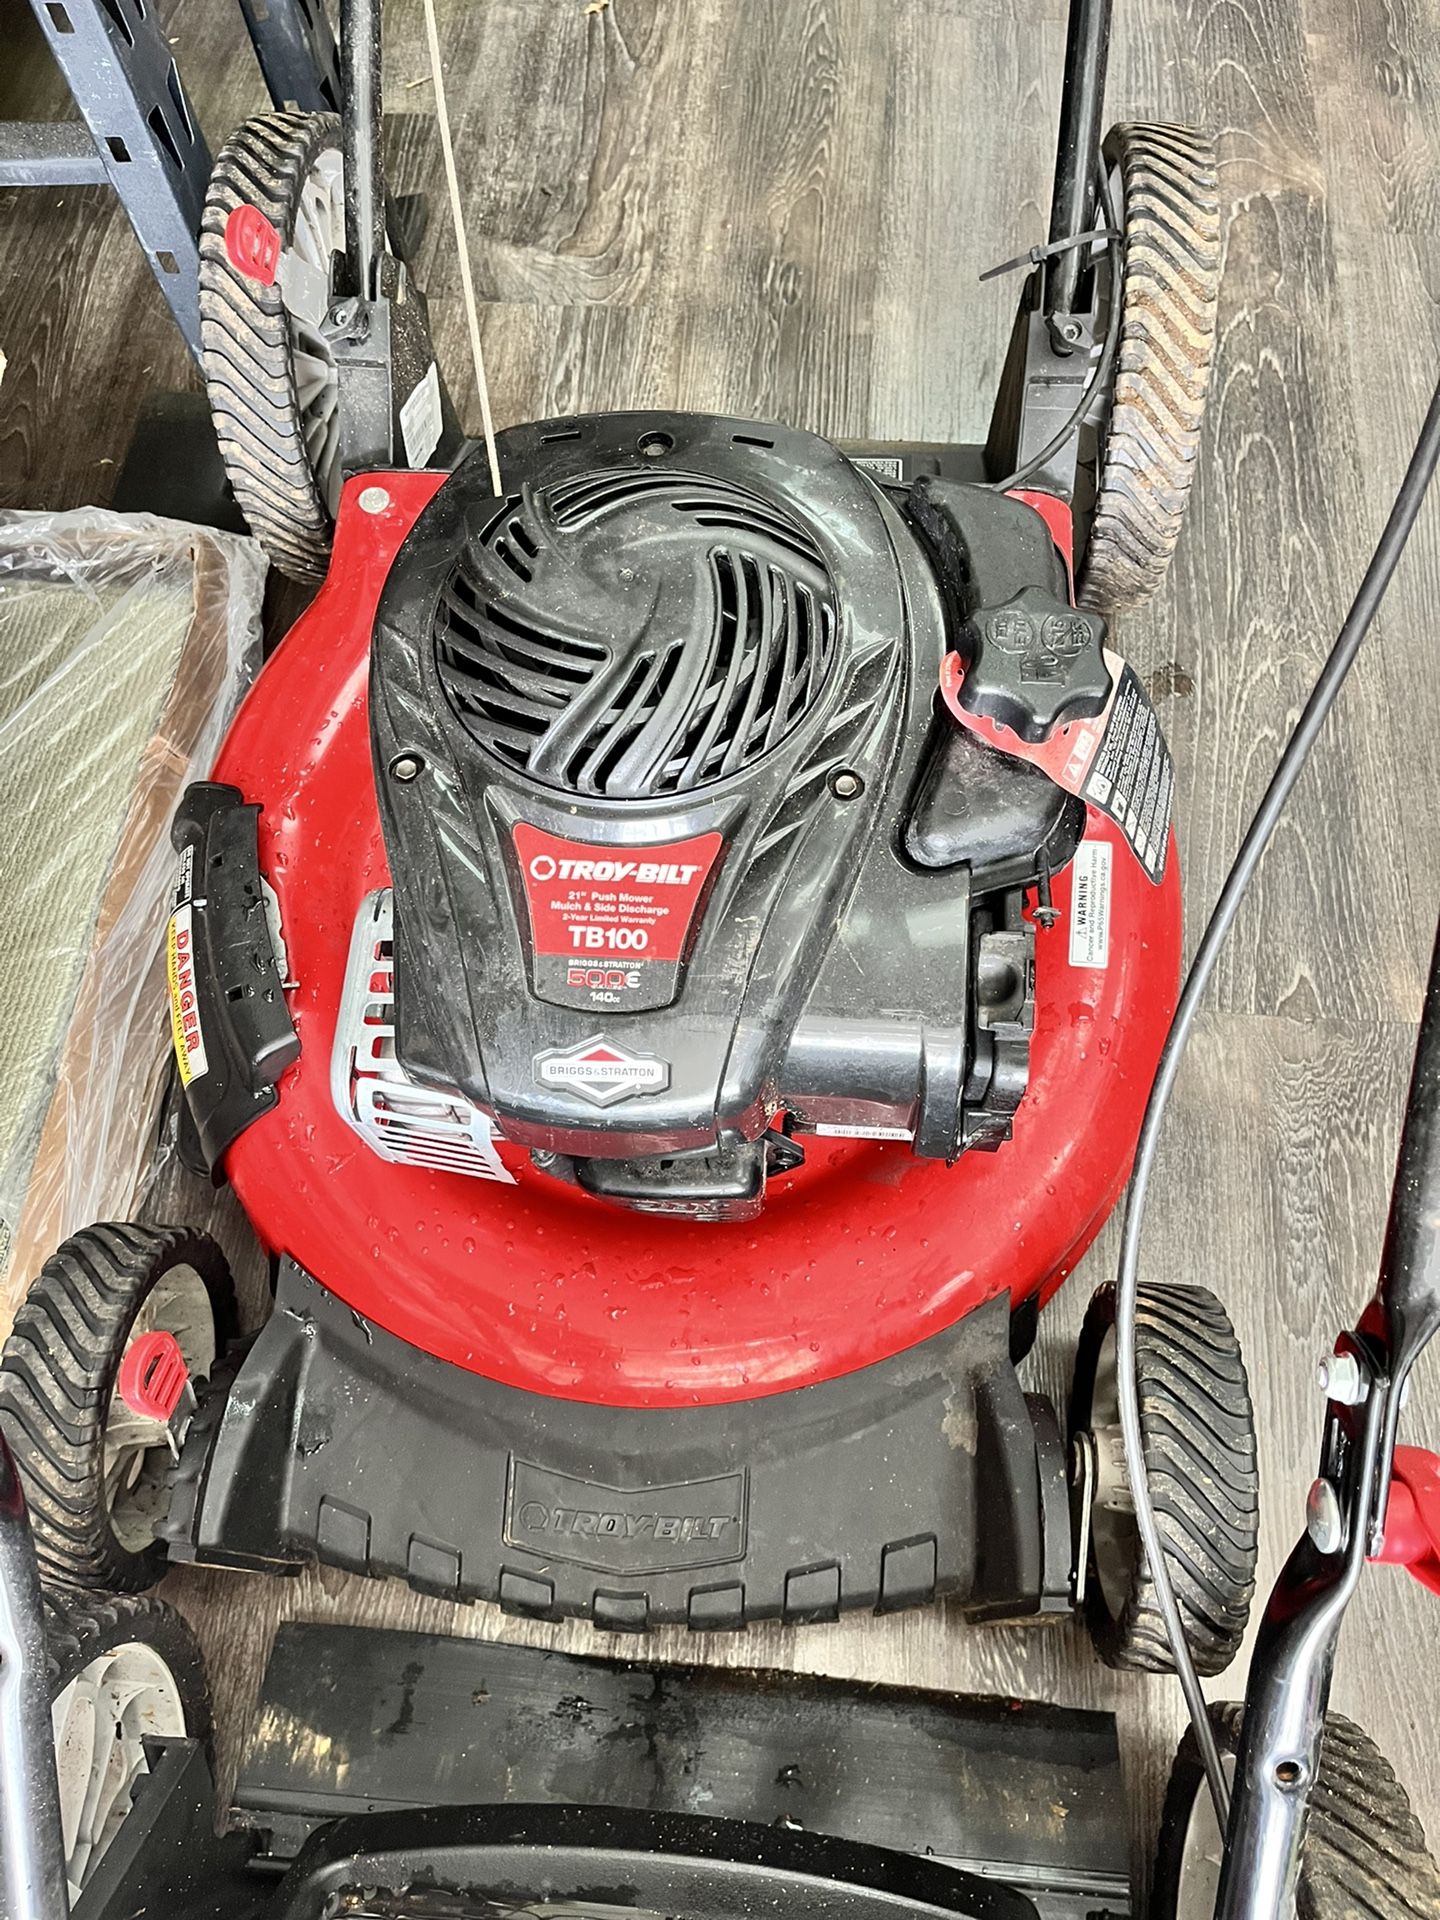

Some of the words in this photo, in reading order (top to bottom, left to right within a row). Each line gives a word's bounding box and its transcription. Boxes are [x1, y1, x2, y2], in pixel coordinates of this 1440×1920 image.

[1090, 848, 1098, 867] Harm
[558, 859, 698, 885] TROY-BILT
[591, 892, 617, 902] Push
[619, 893, 654, 903] Mower
[1077, 875, 1089, 926] WARNING
[1088, 870, 1098, 918] Reproductive
[1097, 857, 1108, 951] www.P65Warnings.ca.gov
[551, 901, 582, 910] Mulch
[584, 902, 592, 911] &
[594, 903, 616, 912] Side
[619, 904, 669, 916] Discharge
[562, 913, 588, 921] 2-Year
[590, 915, 619, 923] Limited
[620, 916, 656, 925] Warranty
[568, 925, 648, 950] TB100
[1087, 936, 1095, 962] Cancer
[171, 953, 179, 990] HANDS
[172, 994, 180, 1011] and
[176, 929, 200, 1053] DANGER
[590, 992, 620, 1003] 140cc
[175, 1014, 184, 1040] FEET
[178, 1044, 191, 1076] AWAY
[554, 1508, 730, 1542] TROY-BILT
